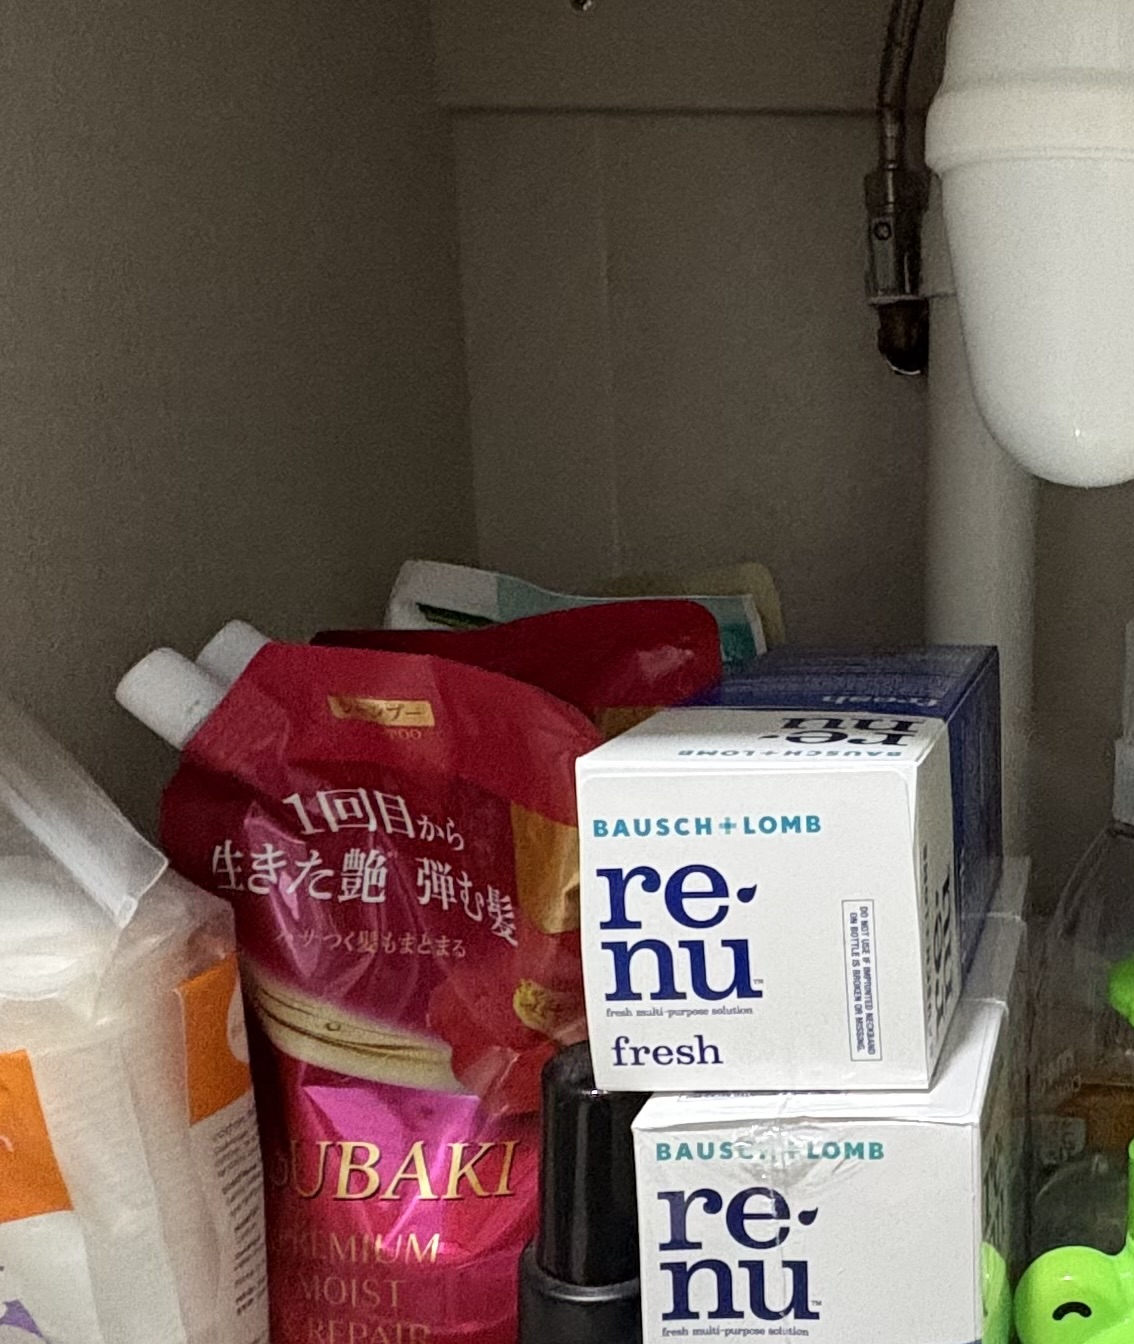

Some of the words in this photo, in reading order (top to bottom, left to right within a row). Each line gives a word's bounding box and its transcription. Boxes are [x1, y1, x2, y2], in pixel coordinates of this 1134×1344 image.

[282, 787, 466, 852] 1回目から
[212, 839, 389, 904] 生きた艶
[415, 857, 519, 948] 弾む髪
[596, 863, 731, 931] re
[849, 912, 858, 924] ON
[859, 906, 869, 918] DO
[850, 926, 860, 958] BOTTLE
[860, 920, 870, 937] NOT
[861, 939, 871, 955] USE
[862, 957, 871, 965] IF
[852, 959, 861, 968] IS
[852, 969, 862, 1002] BROKEN
[863, 967, 874, 1011] IMPRINTED
[606, 1007, 633, 1017] fresh
[636, 1006, 709, 1019] multi-purpose
[711, 1006, 754, 1016] solution
[854, 1003, 864, 1015] OR
[865, 1012, 876, 1055] NECKBAND
[611, 1035, 724, 1066] fresh
[657, 1186, 791, 1252] re
[302, 1273, 408, 1312] MOIST
[662, 1327, 688, 1337] fresh
[692, 1326, 765, 1338] multi-purpose
[768, 1326, 810, 1336] solution
